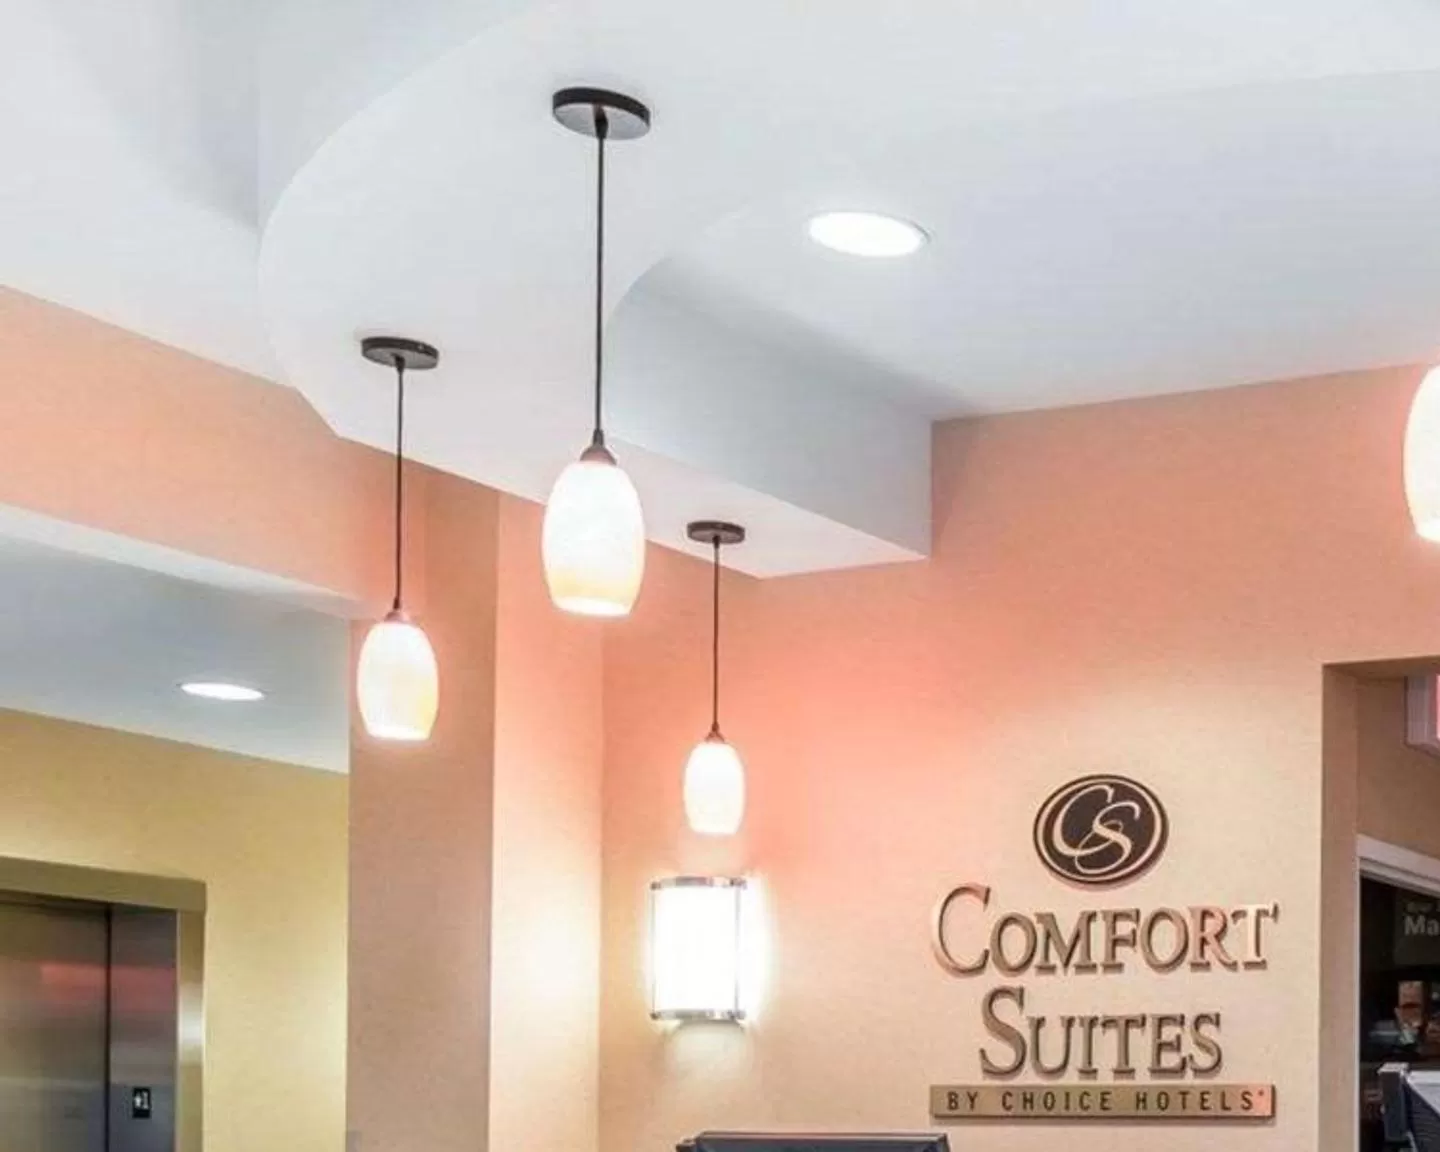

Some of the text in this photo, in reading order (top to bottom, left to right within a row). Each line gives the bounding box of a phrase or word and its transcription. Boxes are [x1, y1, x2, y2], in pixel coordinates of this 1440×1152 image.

[947, 1089, 1255, 1111] BY CHOICE HOTELS
